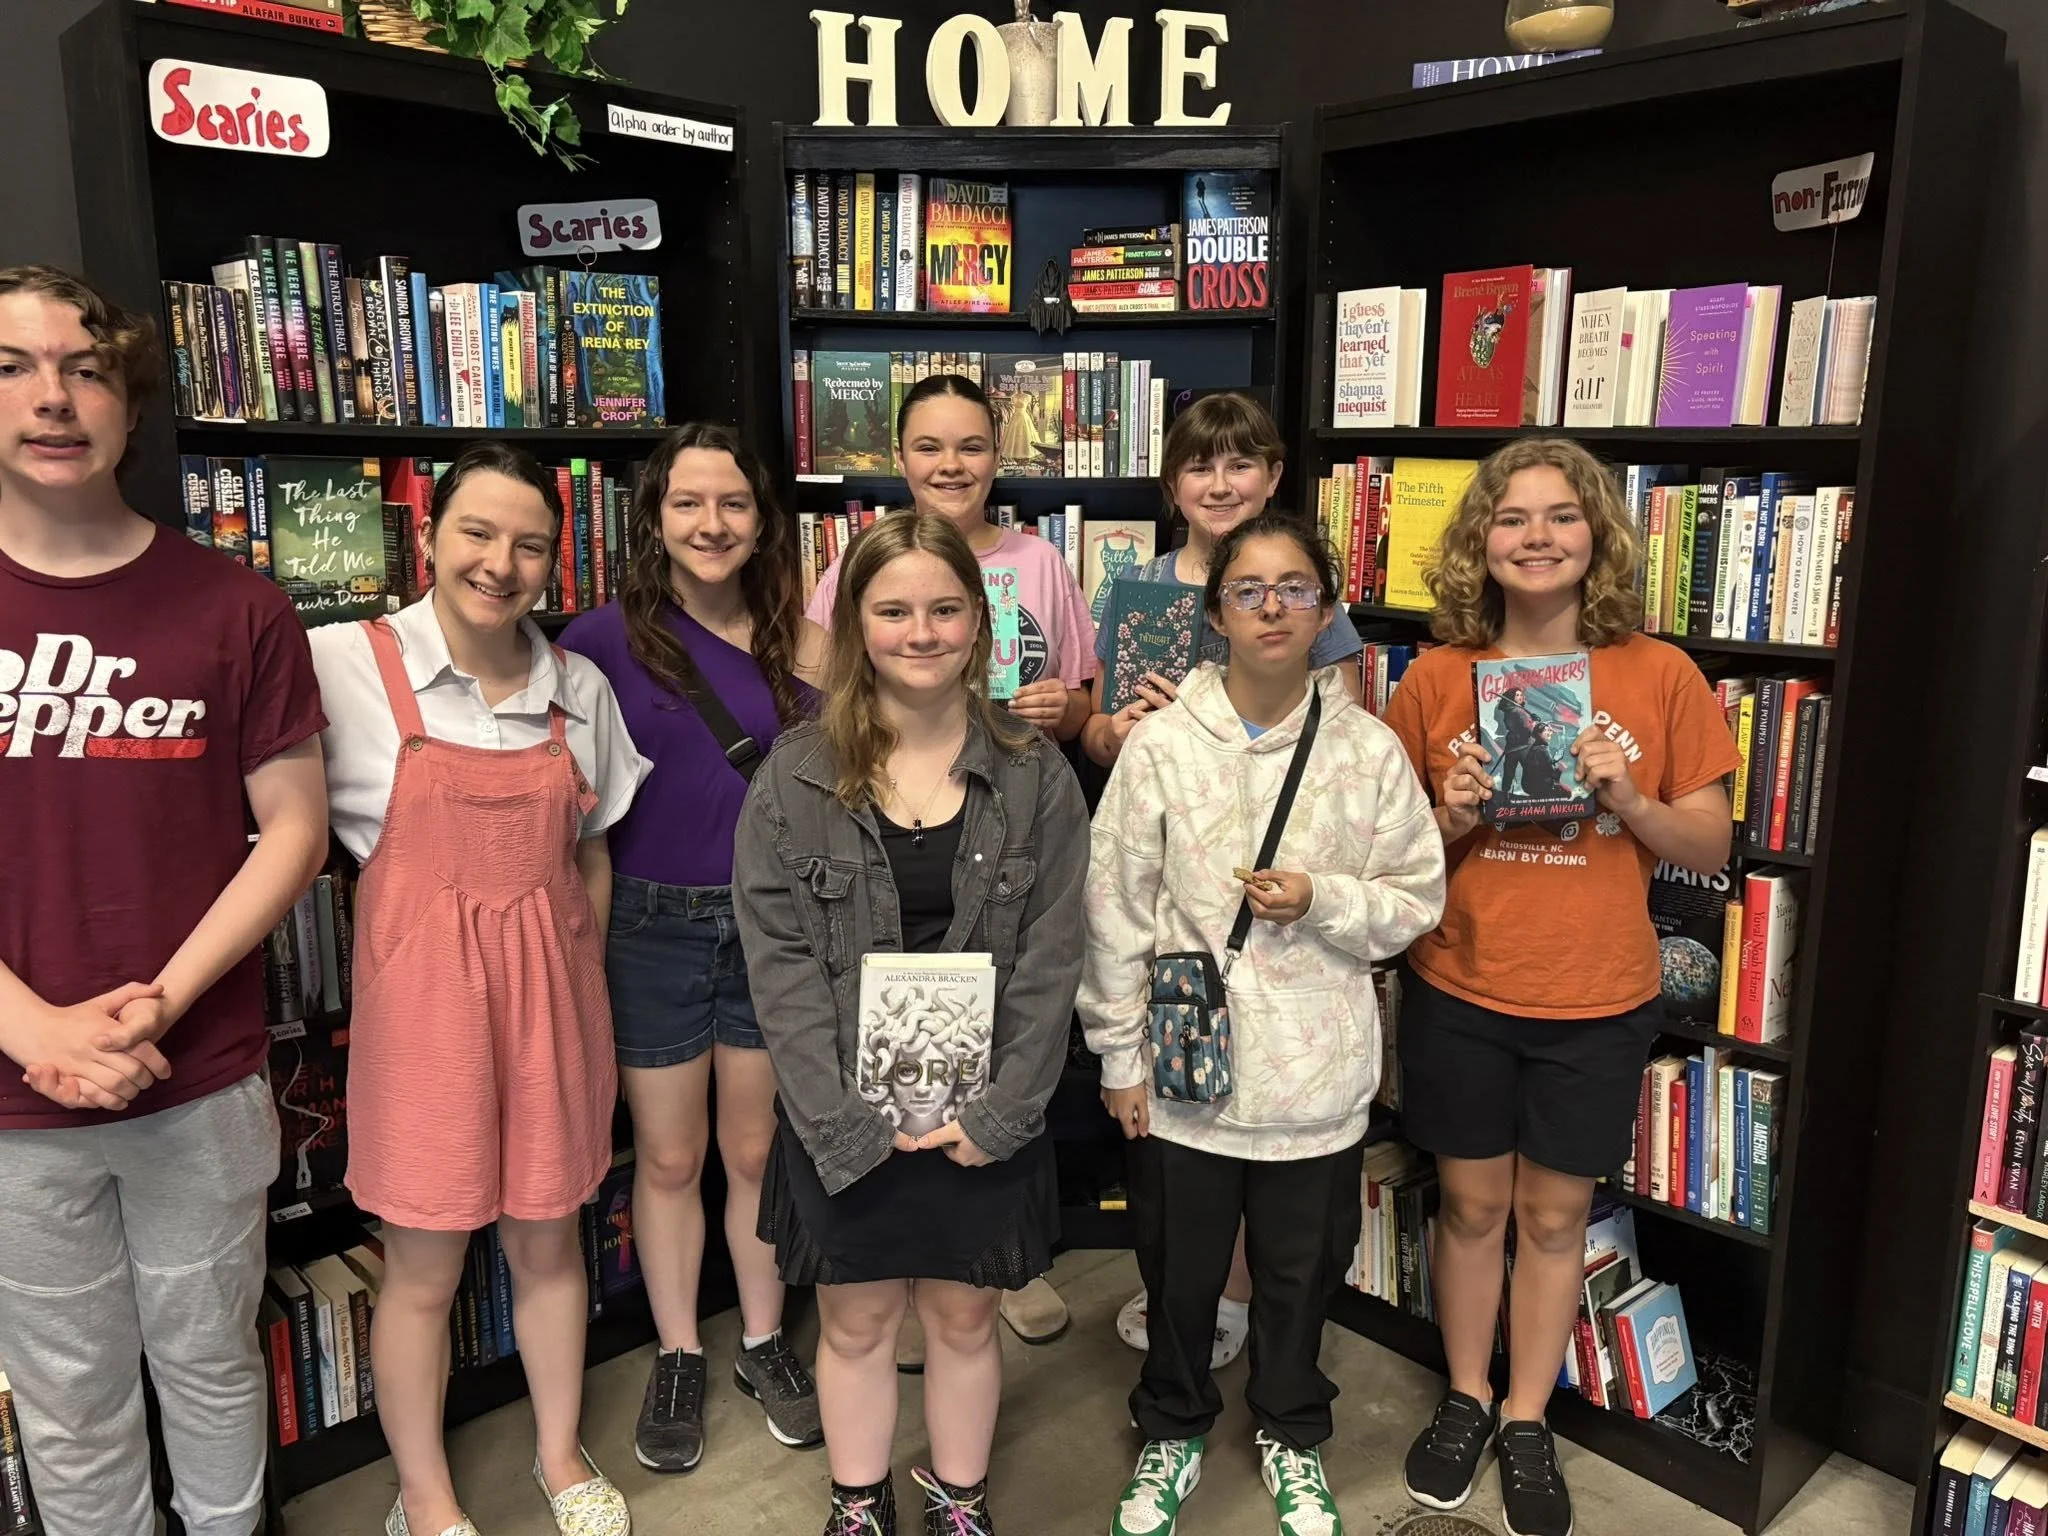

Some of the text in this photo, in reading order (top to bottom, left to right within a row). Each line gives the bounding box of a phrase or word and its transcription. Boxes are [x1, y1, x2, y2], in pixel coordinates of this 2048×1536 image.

[242, 5, 321, 27] ALAFAIR BURKE
[809, 9, 1231, 126] HOME
[160, 67, 310, 153] Scaries
[611, 112, 732, 145] Alpha order by author
[946, 183, 991, 203] DAVID
[817, 186, 830, 269] DAVID BALDACCI
[838, 189, 849, 266] DAVID BALDACCI
[860, 191, 870, 255] DAVID BALDACCI
[901, 178, 913, 250] DAVID BALDACCI
[931, 204, 1008, 224] BALDACCI
[1188, 216, 1268, 237] JAMES PATTERSON
[528, 208, 648, 248] Scaries
[261, 249, 272, 263] WE
[1188, 236, 1268, 264] DOUBLE
[931, 244, 1008, 285] MERCY
[263, 265, 278, 294] WERE
[1083, 282, 1161, 297] JAMES PATTERSON GONE
[1188, 263, 1268, 310] CROSS
[1454, 282, 1519, 298] Brené Brown
[253, 286, 265, 325] BALLARD
[600, 288, 626, 299] THE
[268, 298, 282, 331] NEVER
[573, 303, 654, 317] EXTINCTION
[1343, 302, 1385, 323] i guess
[1581, 314, 1611, 329] WHEN
[449, 309, 463, 357] LEE CHILD
[490, 308, 498, 343] HUNTING
[605, 321, 625, 332] OF
[1344, 319, 1390, 338] haven't
[1579, 331, 1609, 344] BREATH
[1690, 329, 1737, 343] Speaking
[258, 331, 272, 374] HIGH-RISE
[395, 279, 416, 405] SANDRA BROWN BLOOD MOON
[581, 337, 650, 350] IRENA REY
[1339, 335, 1390, 353] learned
[1578, 348, 1608, 359] BECOMES
[1704, 348, 1719, 356] with
[470, 329, 482, 406] GHOST CAMERA
[492, 345, 500, 370] WIVES
[1339, 353, 1385, 372] that yet
[1696, 363, 1724, 375] Spirit
[823, 377, 884, 390] Redeemed by
[830, 389, 876, 401] MERCY
[1339, 382, 1384, 401] shauna
[1574, 376, 1605, 401] air
[592, 397, 646, 409] JENNIFER
[601, 411, 639, 422] CROFT
[1337, 399, 1387, 417] niequist
[188, 472, 209, 514] CLIVE CUSSLER
[220, 468, 244, 515] CLIVE CUSSLER
[278, 478, 371, 505] The Last
[1396, 495, 1447, 507] Trimester
[1397, 482, 1444, 494] The Fifth
[257, 497, 267, 537] CUSSLER
[1330, 477, 1341, 530] NUTRIVORE
[293, 503, 361, 533] Thing
[312, 526, 342, 551] He
[1363, 488, 1379, 587] AMERICAN KINGPIN
[285, 549, 375, 576] Told Me
[1676, 488, 1695, 620] BAD WITH MONEY GABY DUNN
[334, 589, 378, 608] Dave
[1831, 576, 1843, 627] David Grann
[1139, 633, 1171, 645] TWILIGHT
[19, 633, 137, 695] Dr
[0, 649, 207, 758] pper
[1758, 684, 1771, 745] MIKE POMPEO
[1593, 710, 1643, 763] PENN
[1520, 806, 1546, 816] HANA
[1550, 804, 1585, 815] MIKUTA
[1521, 852, 1539, 863] BY
[1544, 854, 1587, 866] DOING
[1551, 845, 1564, 853] NC
[1742, 939, 1753, 970] Nexus
[1751, 911, 1766, 1002] Yuval Noah Harari
[884, 975, 978, 983] ALEXANDRA BRACKEN
[2022, 1043, 2044, 1068] Sex
[872, 1056, 977, 1086] LORE
[2013, 1085, 2035, 1124] Vanity
[1753, 1121, 1768, 1166] AMERICA
[2014, 1130, 2026, 1159] KEVIN
[2008, 1161, 2021, 1190] KWAN
[2036, 1187, 2046, 1220] LAROUX
[1961, 1254, 1984, 1350] THIS SPELLS LOVE
[2031, 1300, 2043, 1329] SMITTEN
[300, 1301, 311, 1359] KARIN SLAUGHTER
[2006, 1291, 2023, 1355] CHASING THE RING
[341, 1358, 350, 1381] MOTEL
[6, 1456, 17, 1483] REBECCA
